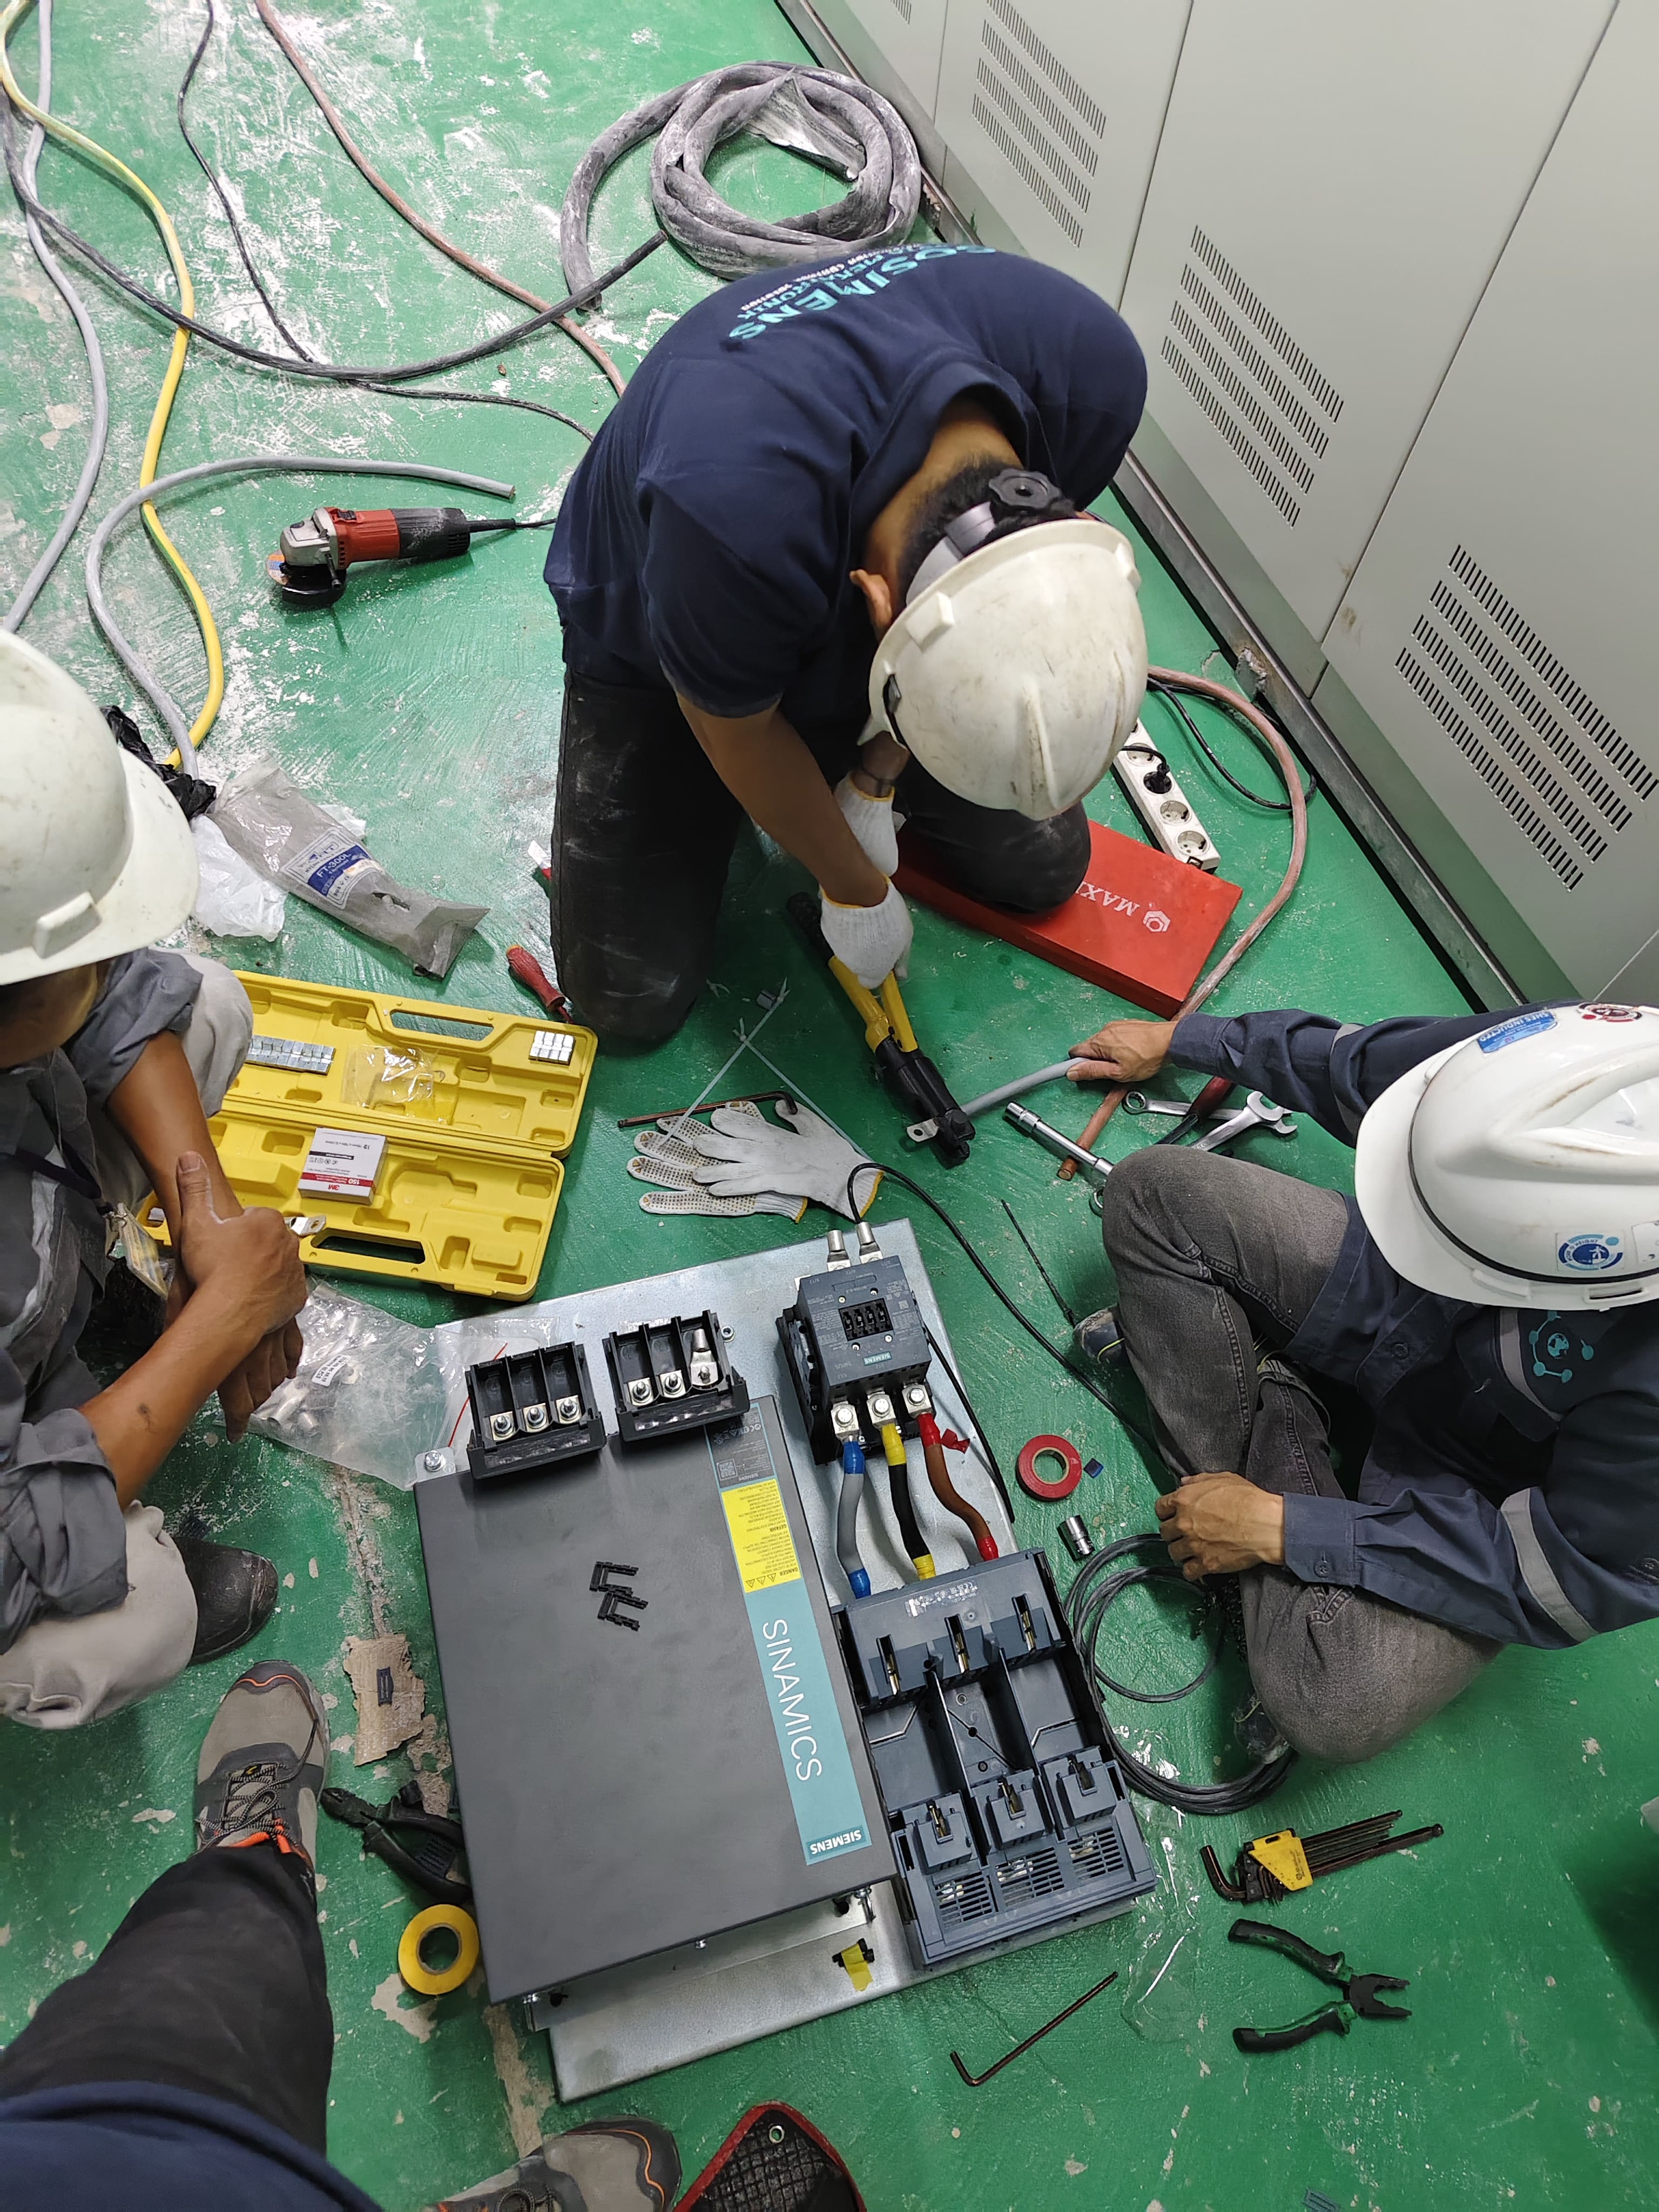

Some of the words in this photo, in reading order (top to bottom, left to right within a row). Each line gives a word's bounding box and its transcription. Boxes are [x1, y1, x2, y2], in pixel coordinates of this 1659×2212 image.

[864, 1352, 892, 1364] SIEMENS
[770, 1524, 787, 1533] GEFAHR
[779, 1567, 798, 1577] DANGER
[762, 1619, 823, 1782] SINAMICS
[810, 1830, 862, 1854] SIEMENS
